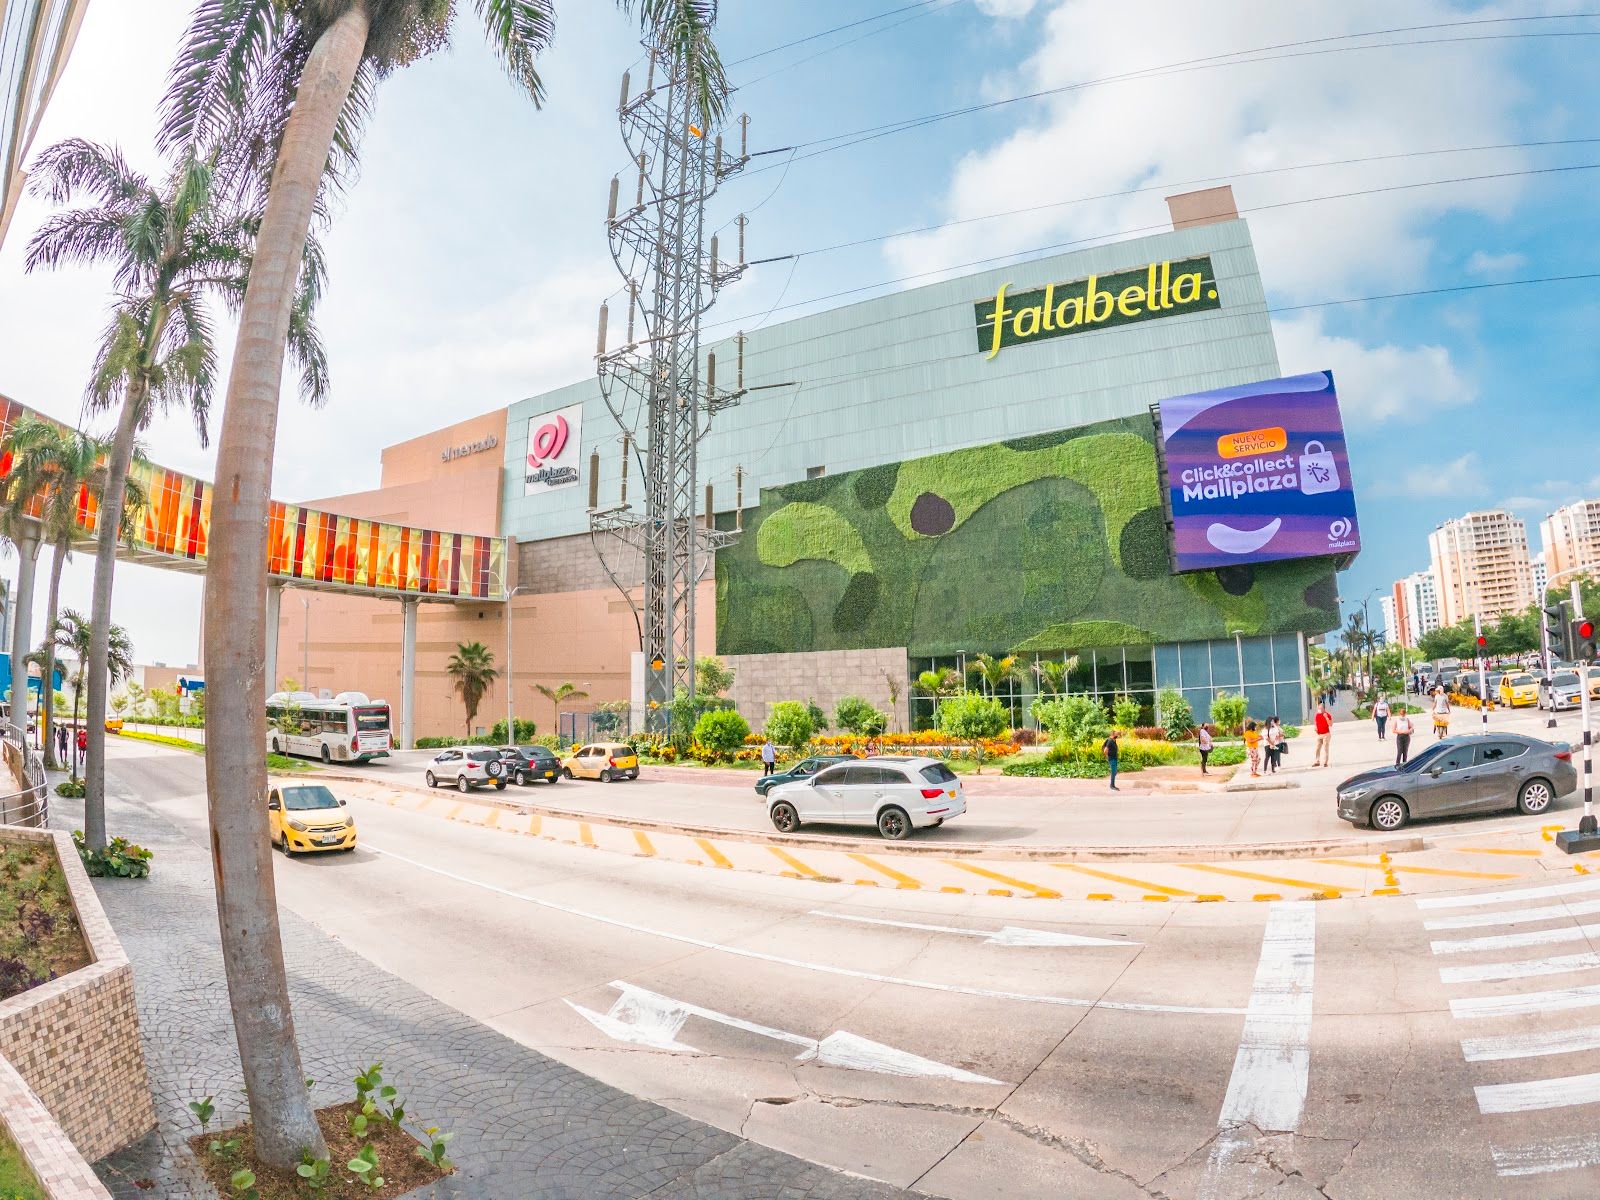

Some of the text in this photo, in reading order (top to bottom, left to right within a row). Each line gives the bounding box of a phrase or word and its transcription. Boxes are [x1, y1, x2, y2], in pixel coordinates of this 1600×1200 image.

[453, 433, 498, 459] mercado
[1233, 433, 1265, 445] NUEVO
[1234, 440, 1276, 453] SERVICIO
[526, 467, 570, 483] mallplaza
[1181, 455, 1295, 483] Click&Collect
[1183, 473, 1298, 502] Mallplaza
[1328, 540, 1356, 548] mallplaza
